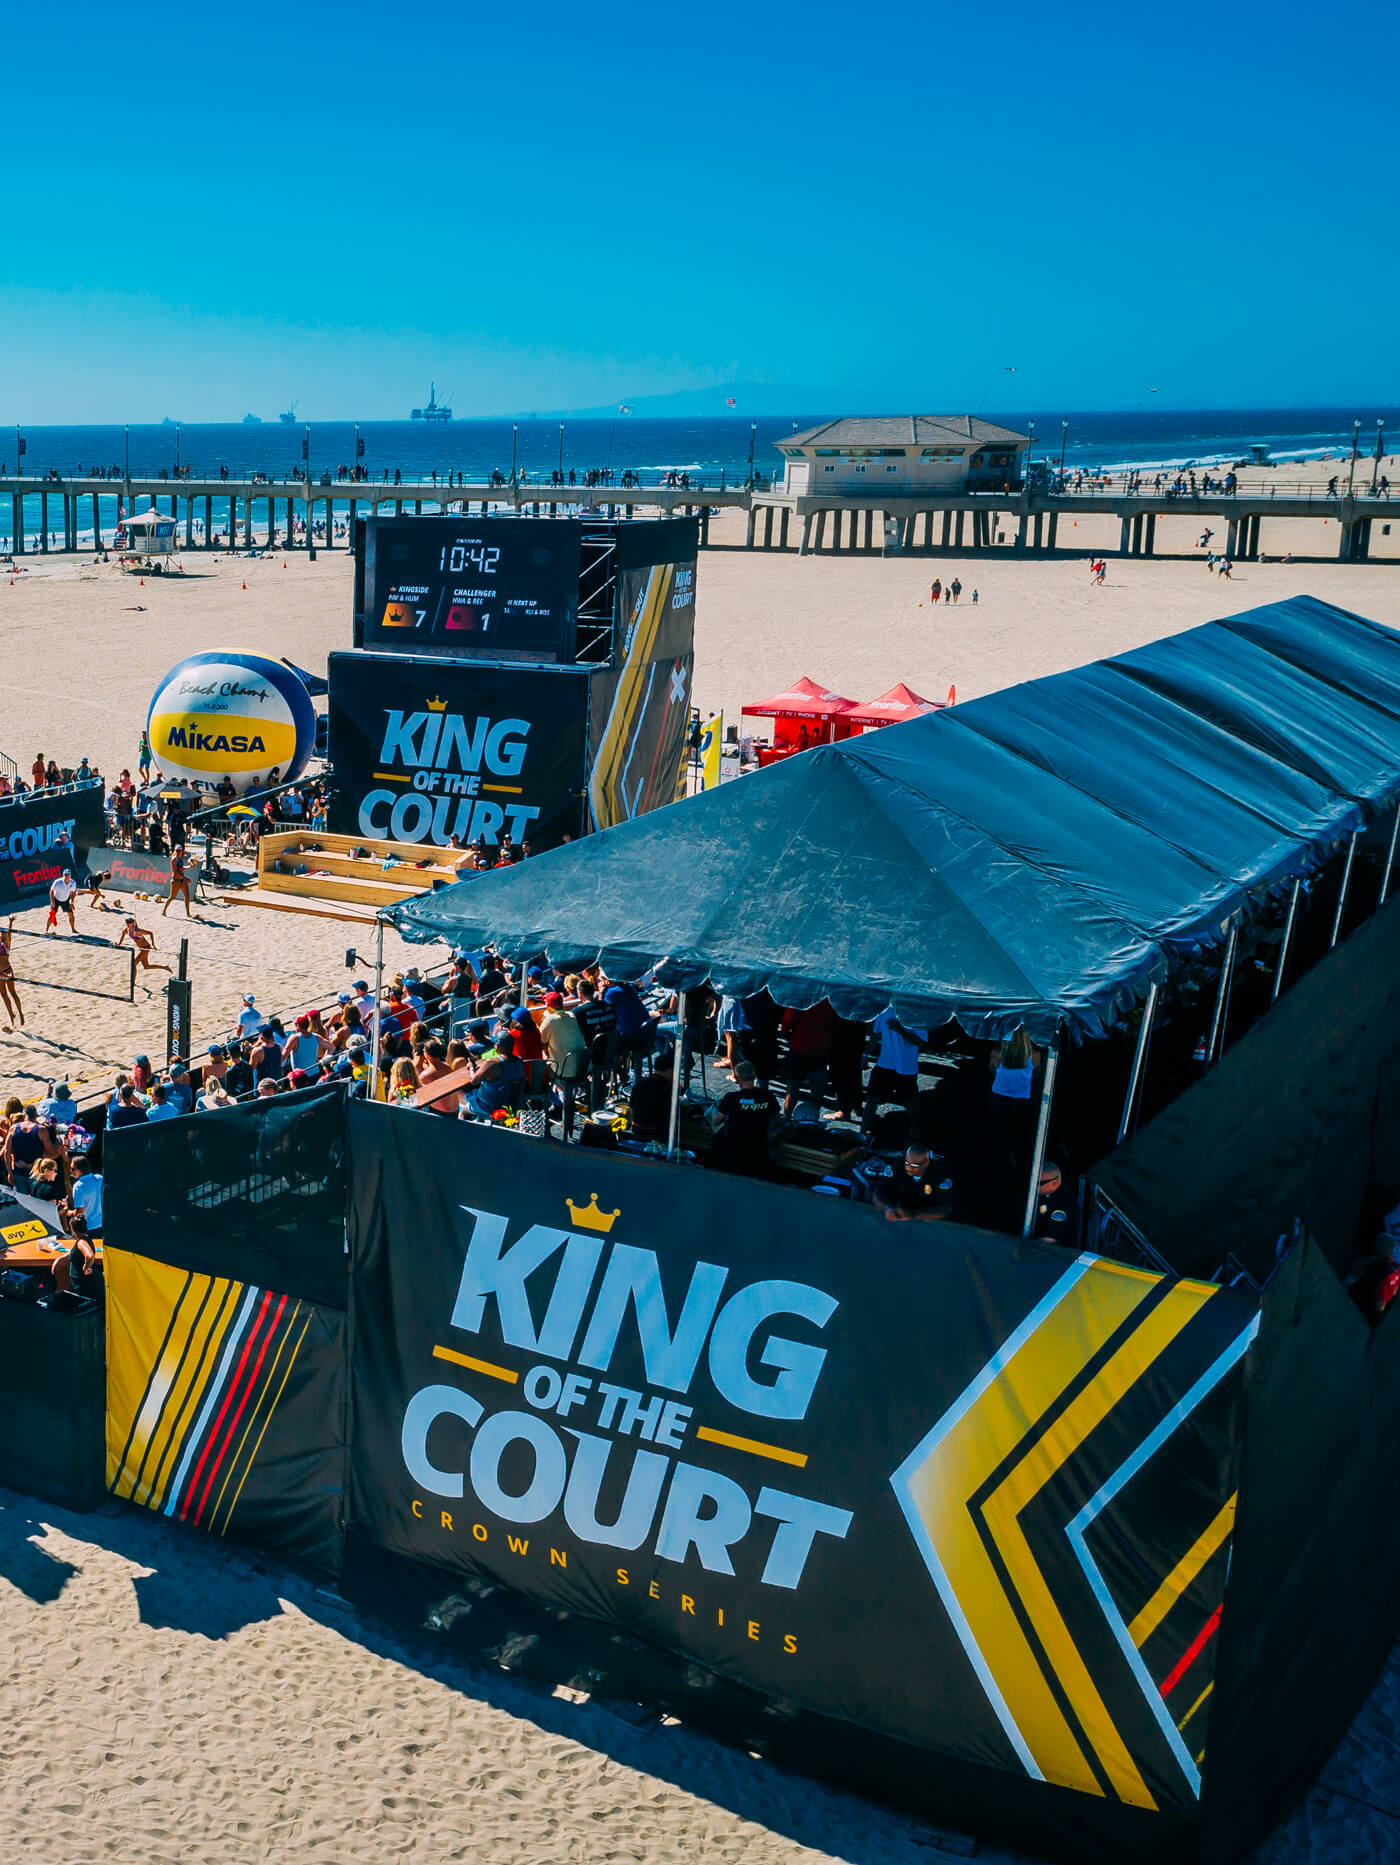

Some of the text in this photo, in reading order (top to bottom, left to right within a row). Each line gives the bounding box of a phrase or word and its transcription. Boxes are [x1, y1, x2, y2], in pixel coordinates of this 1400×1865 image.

[440, 546, 500, 573] 10:42
[398, 586, 429, 594] KINGSIDE
[675, 570, 692, 588] KING
[453, 589, 497, 598] CHALLENGER
[415, 610, 426, 627] 7
[481, 613, 490, 631] 1
[179, 681, 269, 703] Beach Champ
[379, 709, 531, 776] KING
[413, 770, 481, 796] OF THE
[358, 789, 541, 846] COURT
[13, 865, 62, 887] Frontier
[111, 861, 172, 884] Frontier
[7, 1229, 25, 1239] avp
[450, 1205, 840, 1420] KING
[523, 1364, 693, 1450] OF THE
[401, 1385, 855, 1590] COURT
[411, 1500, 798, 1654] CROWN SERIES
